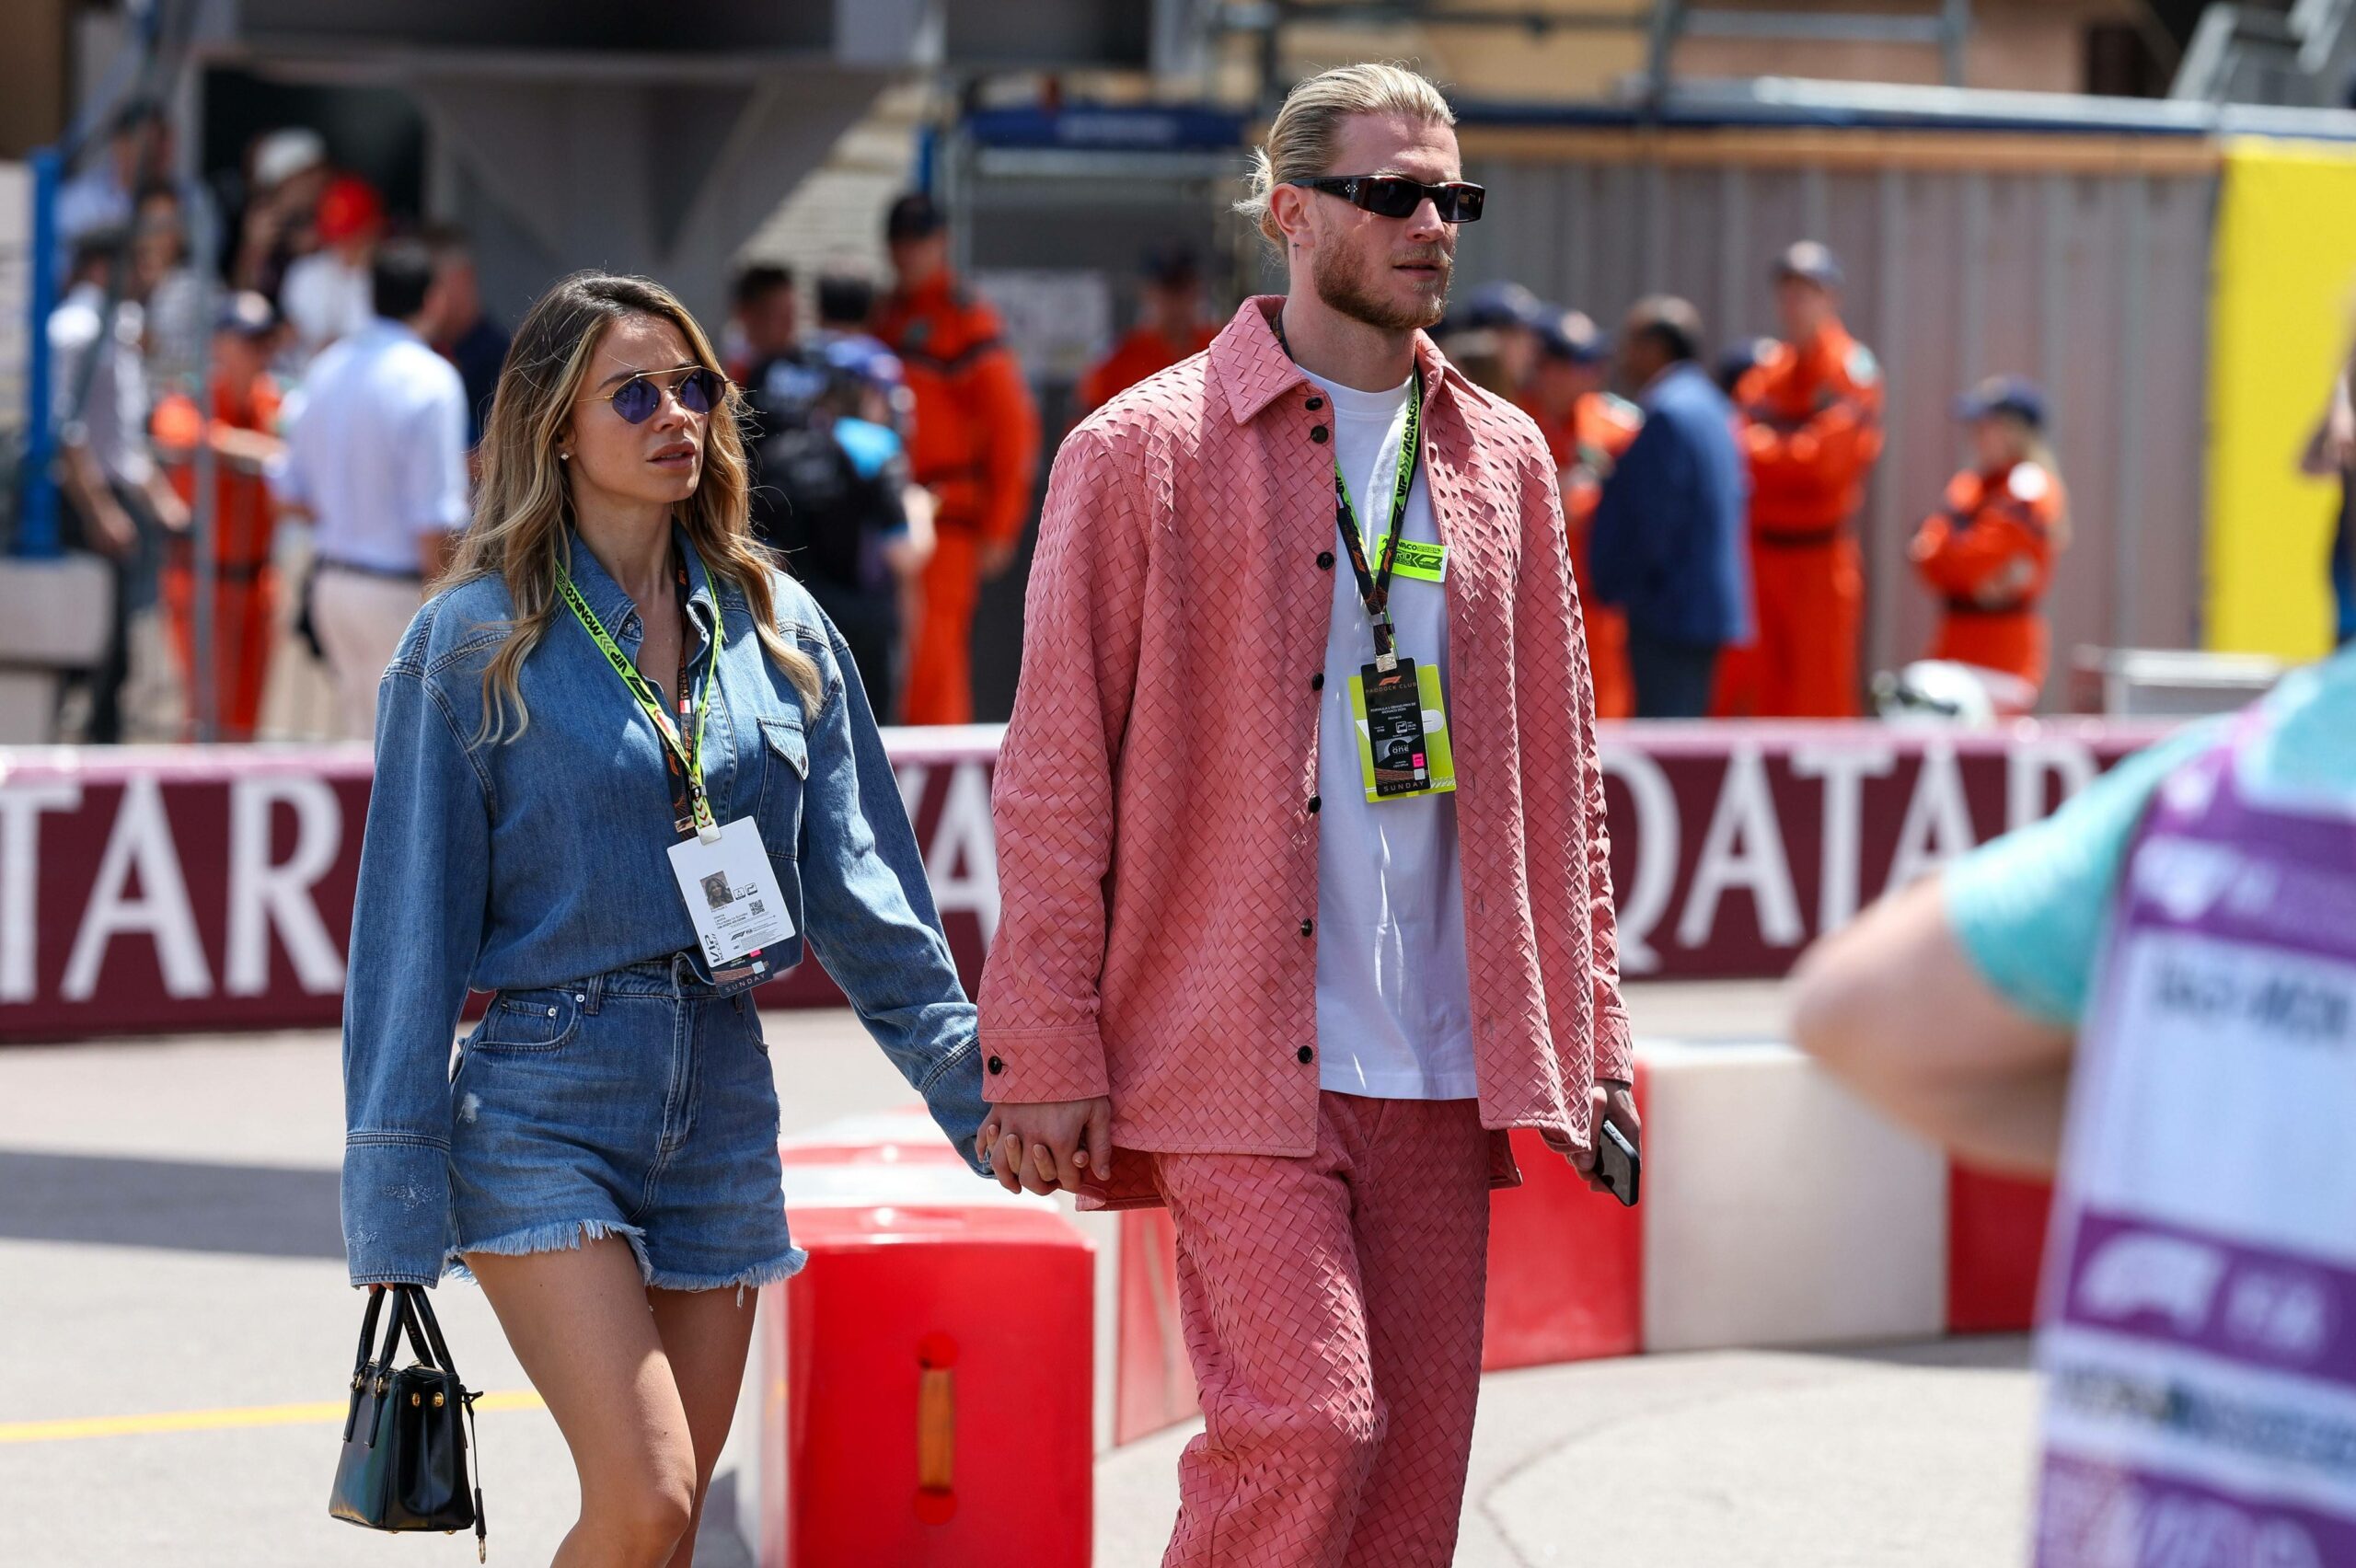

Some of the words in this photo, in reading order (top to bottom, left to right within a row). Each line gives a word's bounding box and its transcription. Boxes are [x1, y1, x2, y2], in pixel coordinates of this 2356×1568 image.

[1396, 474, 1408, 498] VIP
[1403, 399, 1418, 457] MONACO
[565, 587, 604, 637] MONACO
[609, 651, 628, 674] VIP
[1365, 685, 1397, 693] PADDOCK
[1399, 681, 1417, 689] CLUB
[1383, 780, 1424, 792] SUNDAY
[704, 934, 721, 963] VIP
[724, 973, 766, 993] SUNDAY
